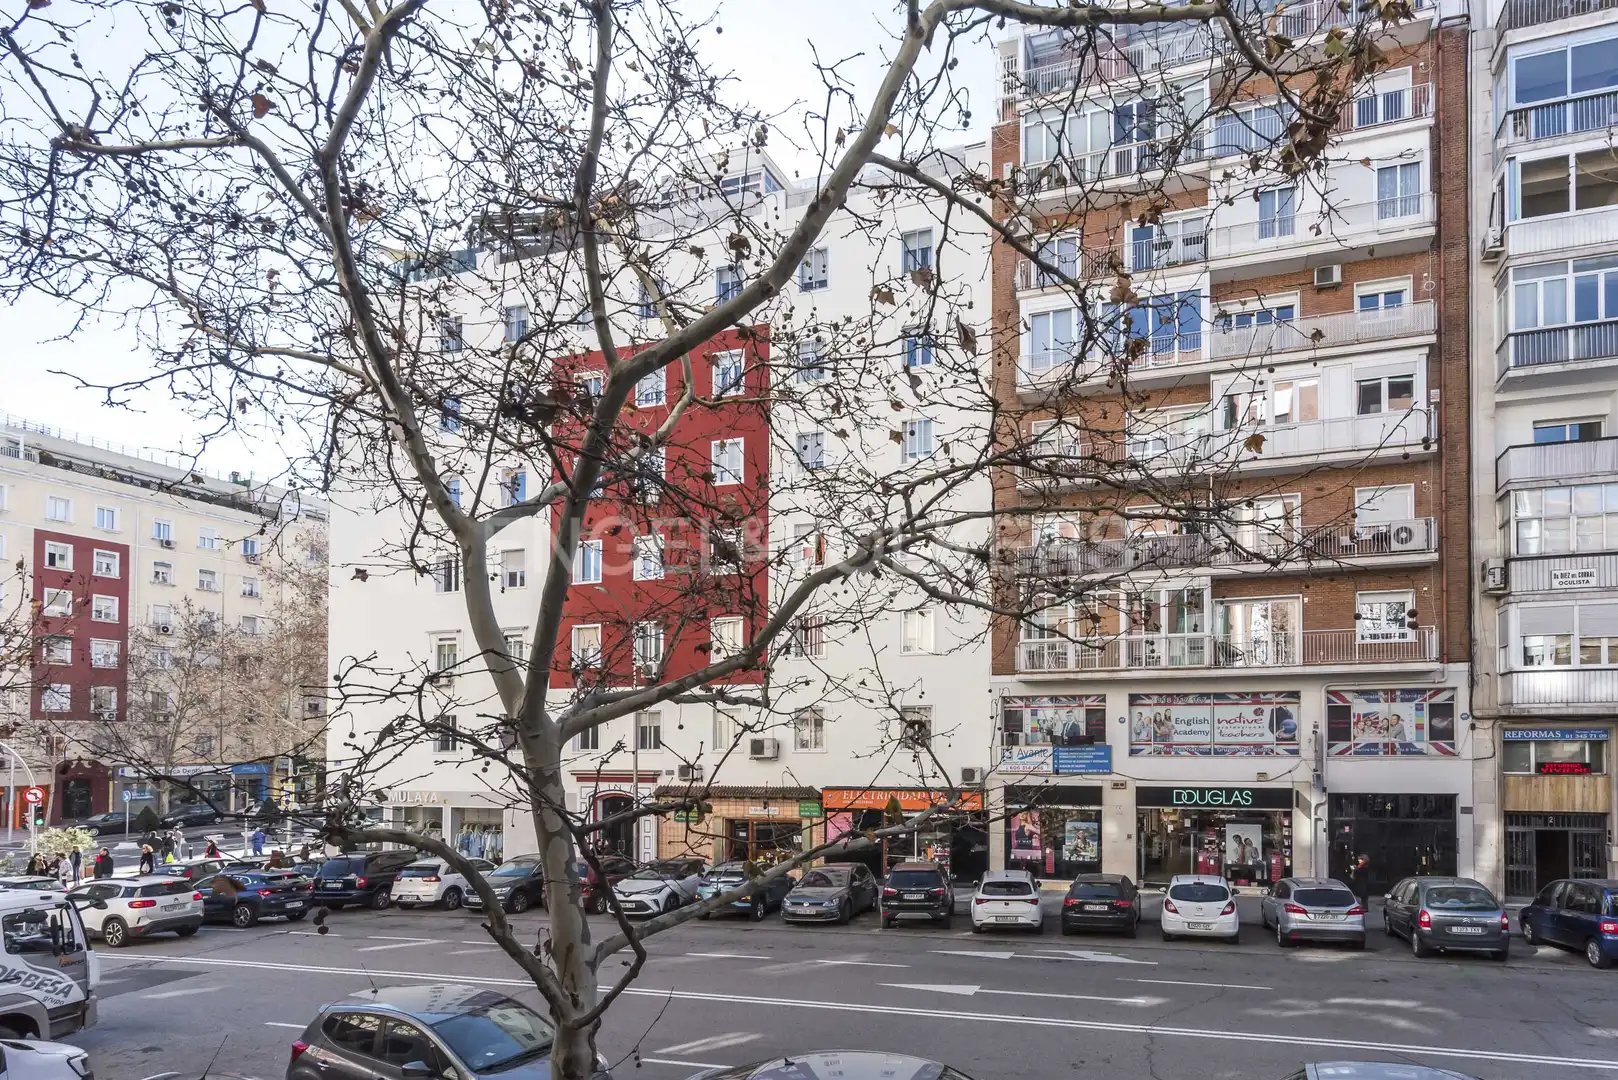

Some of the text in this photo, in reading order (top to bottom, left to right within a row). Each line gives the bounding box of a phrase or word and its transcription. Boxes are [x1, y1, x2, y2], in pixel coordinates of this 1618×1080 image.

[1175, 717, 1210, 726] English
[1217, 712, 1264, 725] native
[1173, 729, 1210, 738] Academy
[1218, 729, 1265, 738] teachers
[1504, 731, 1562, 739] REFORMAS
[388, 791, 439, 802] MULAYA
[1173, 789, 1253, 805] DOUGLAS
[1385, 802, 1392, 810] 4
[42, 995, 65, 1005] grupo
